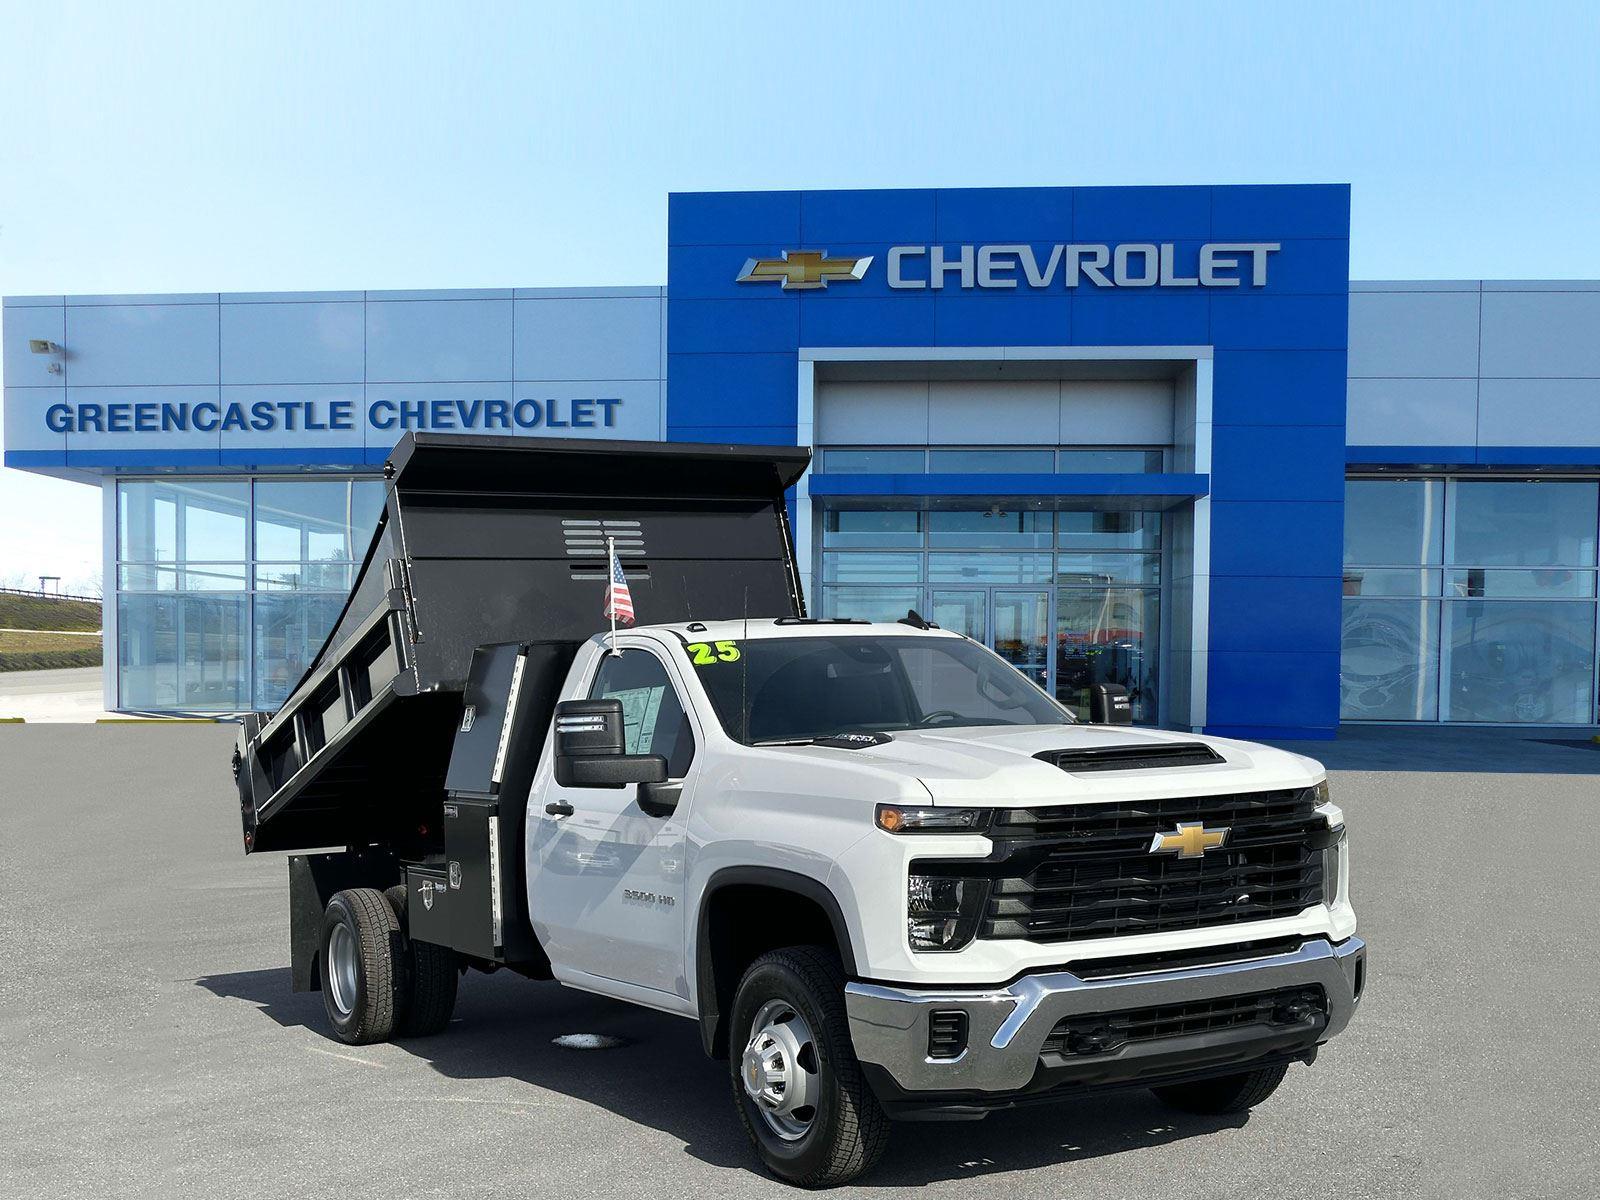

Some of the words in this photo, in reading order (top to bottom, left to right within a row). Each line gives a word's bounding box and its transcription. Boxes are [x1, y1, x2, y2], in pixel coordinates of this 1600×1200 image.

[887, 242, 1281, 289] CHEVROLET
[45, 400, 353, 433] GREENCASTLE
[368, 399, 622, 430] CHEVROLET
[686, 640, 741, 665] 25
[624, 889, 656, 903] 3500
[658, 894, 676, 906] HD
